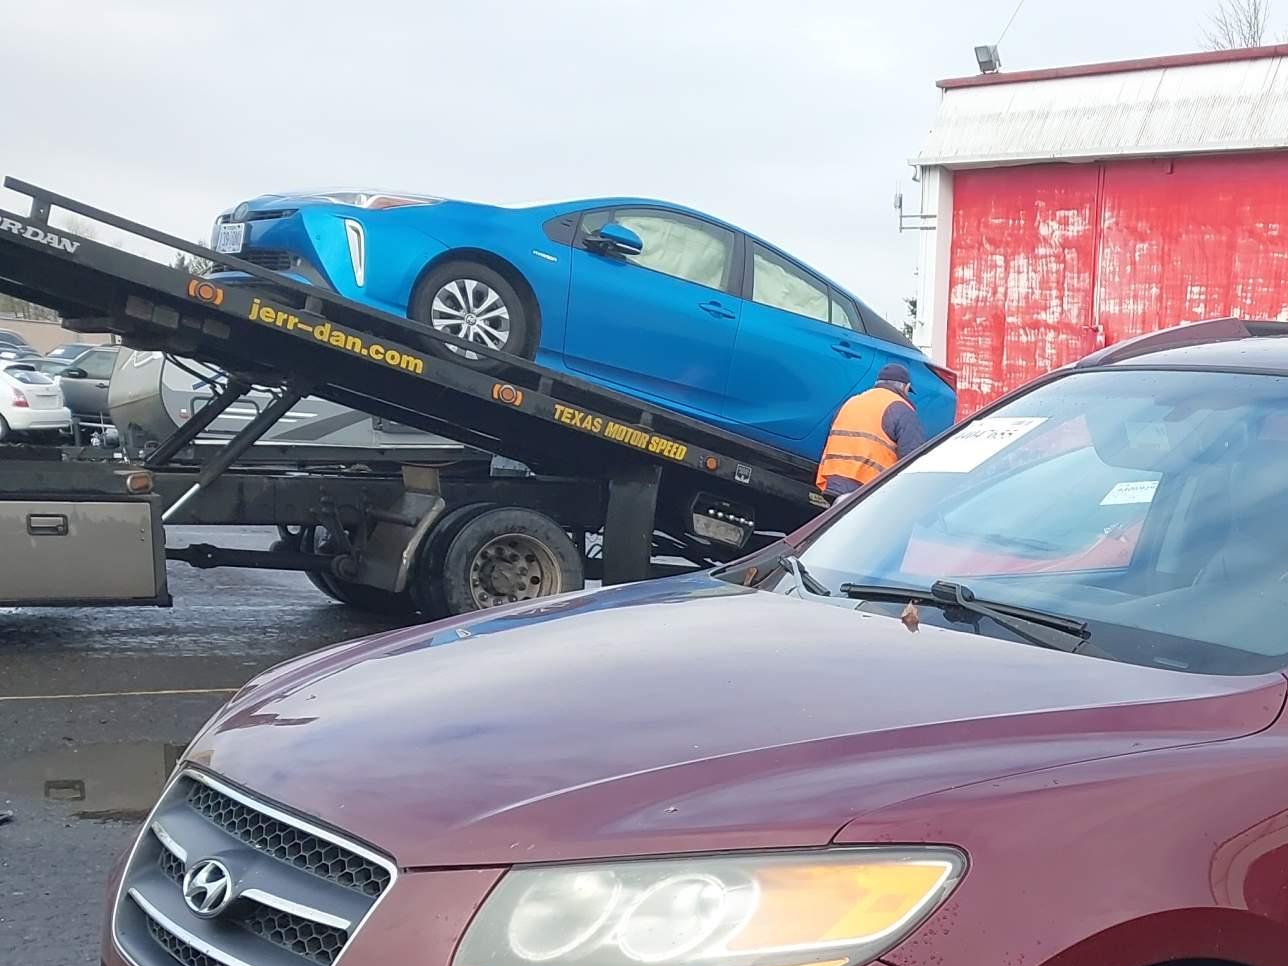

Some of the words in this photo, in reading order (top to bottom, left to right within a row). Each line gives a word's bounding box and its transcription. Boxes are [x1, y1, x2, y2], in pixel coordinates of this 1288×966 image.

[0, 216, 80, 254] R-DAN
[248, 298, 424, 374] jerr-dan.com
[553, 404, 603, 432] TEXAS
[604, 421, 650, 449] MOTOR
[649, 436, 688, 461] SPEED
